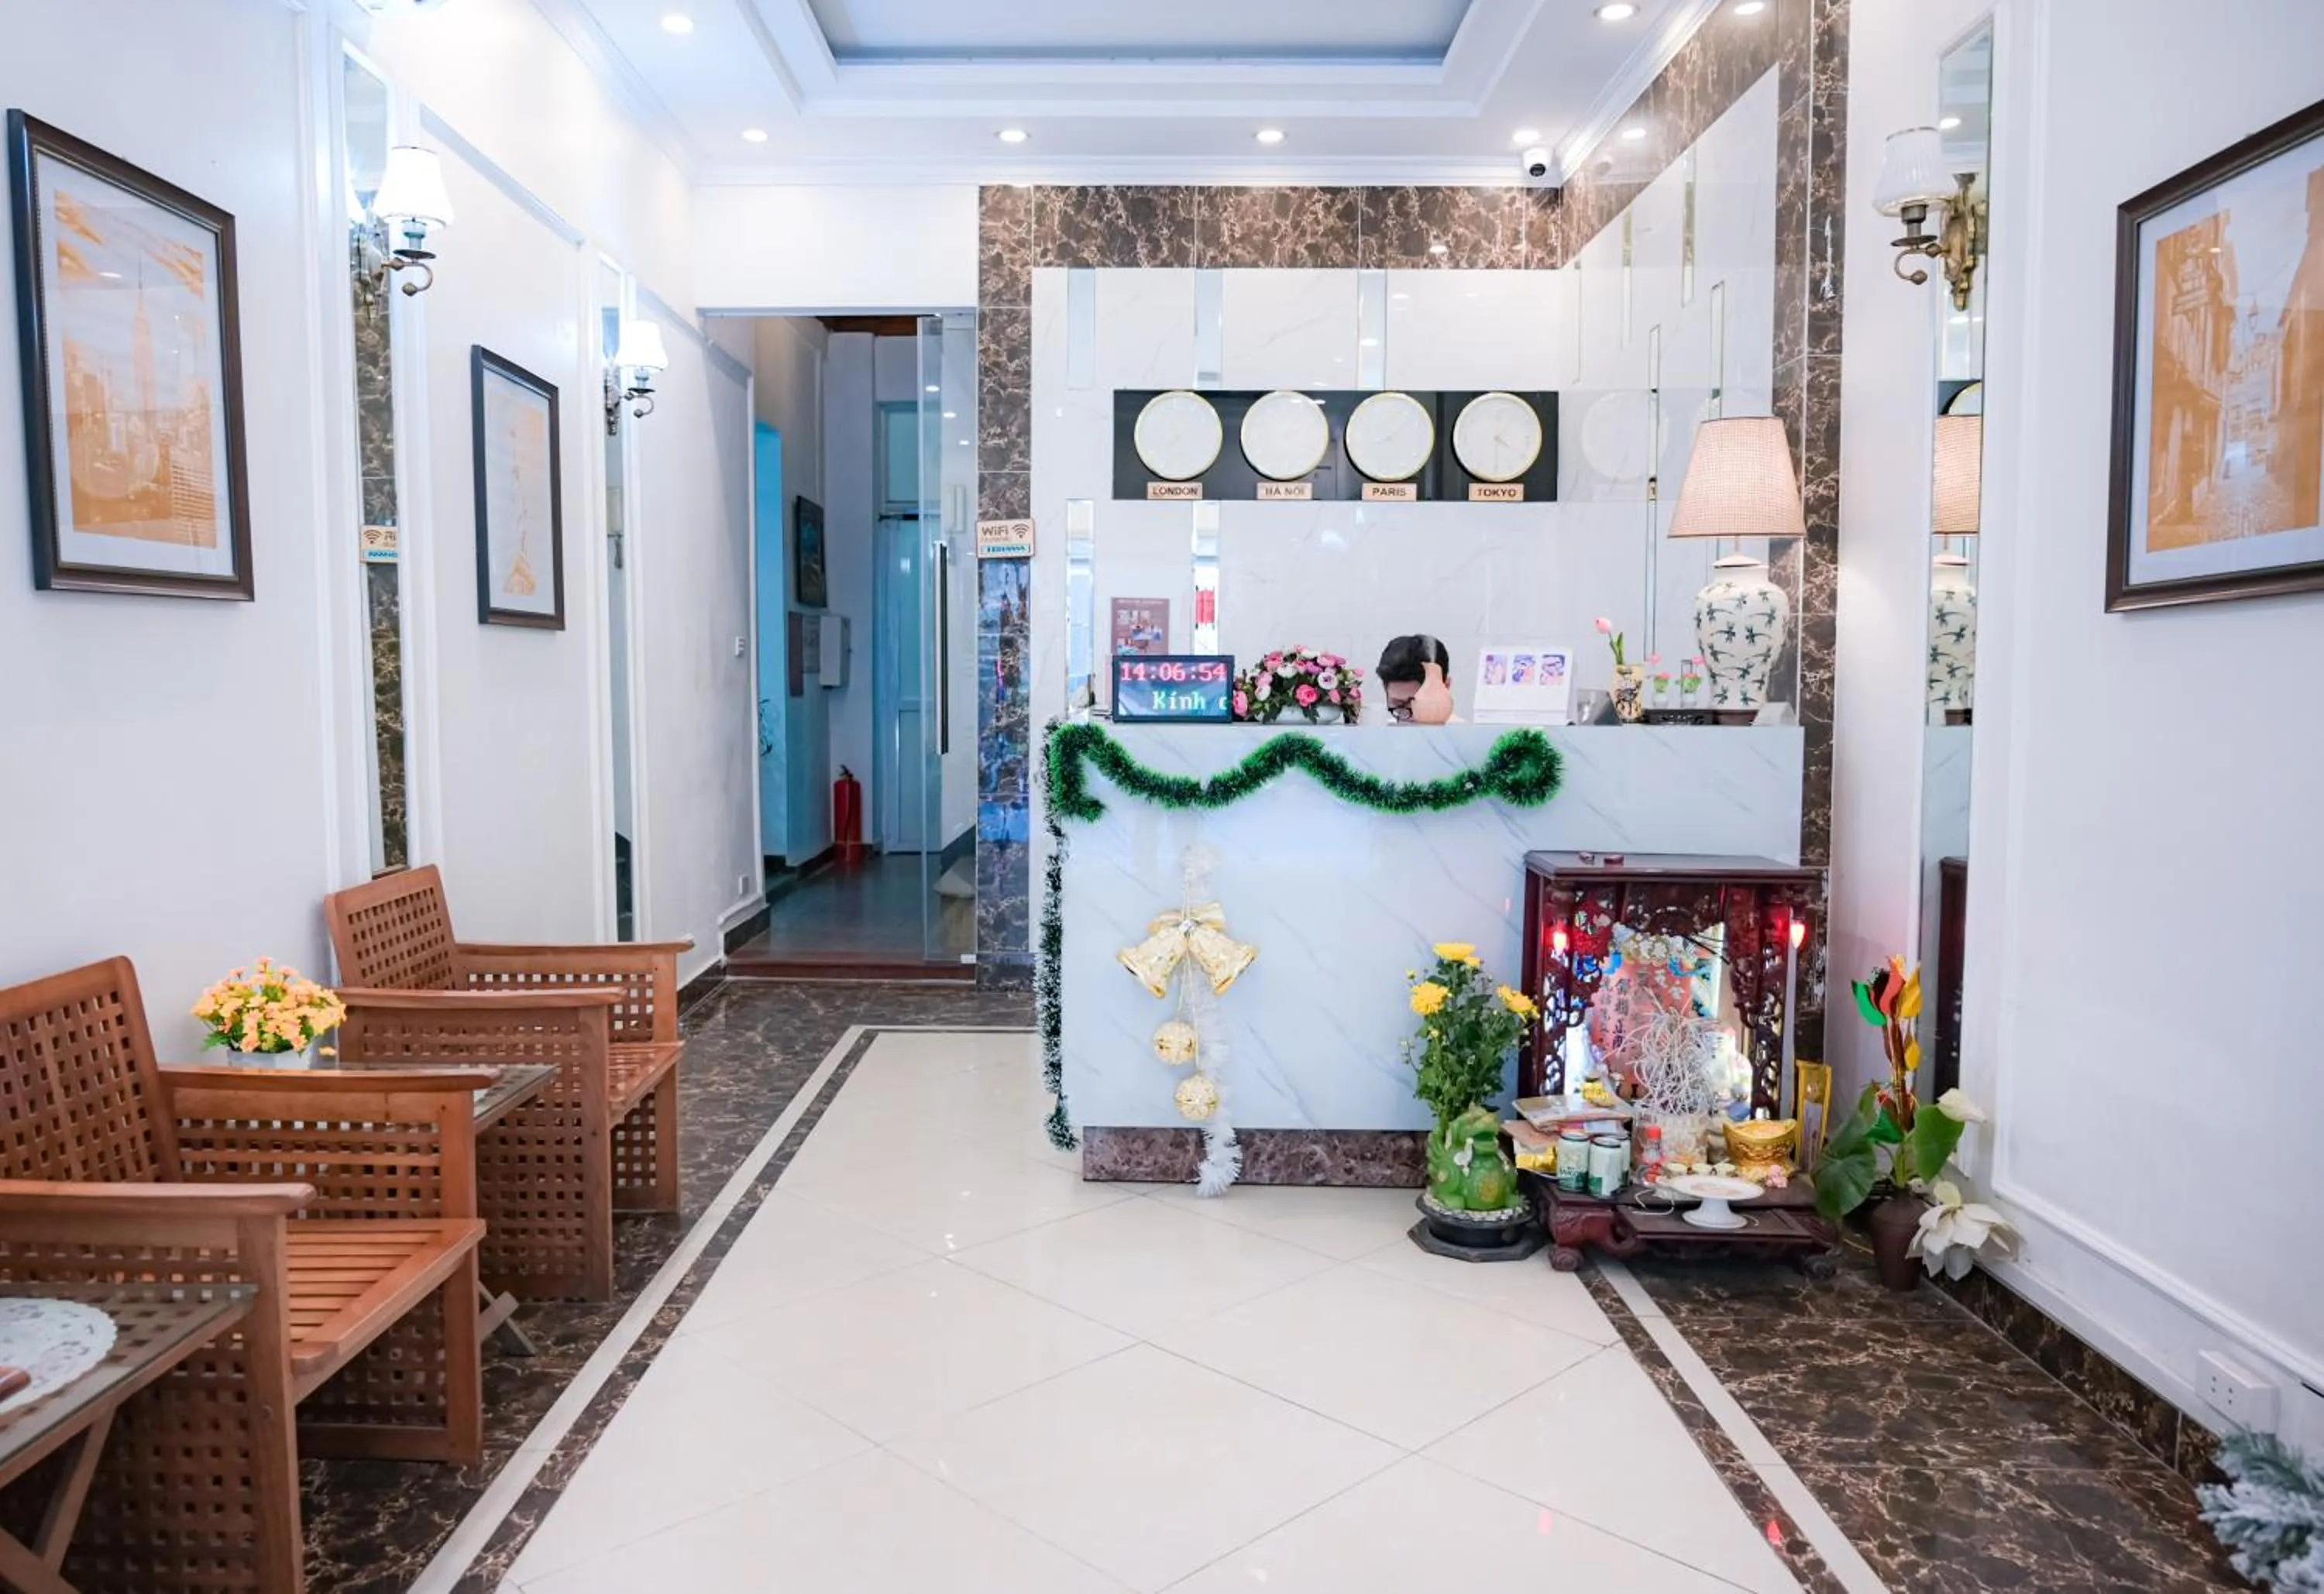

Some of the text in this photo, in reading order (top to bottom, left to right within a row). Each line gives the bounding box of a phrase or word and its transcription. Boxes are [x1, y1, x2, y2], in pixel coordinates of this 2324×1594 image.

[1152, 487, 1198, 496] LONDON
[1372, 487, 1407, 496] PARIS
[1477, 488, 1516, 497] TOKYO
[1120, 662, 1228, 682] 14:06:54
[1152, 690, 1207, 710] Kính
